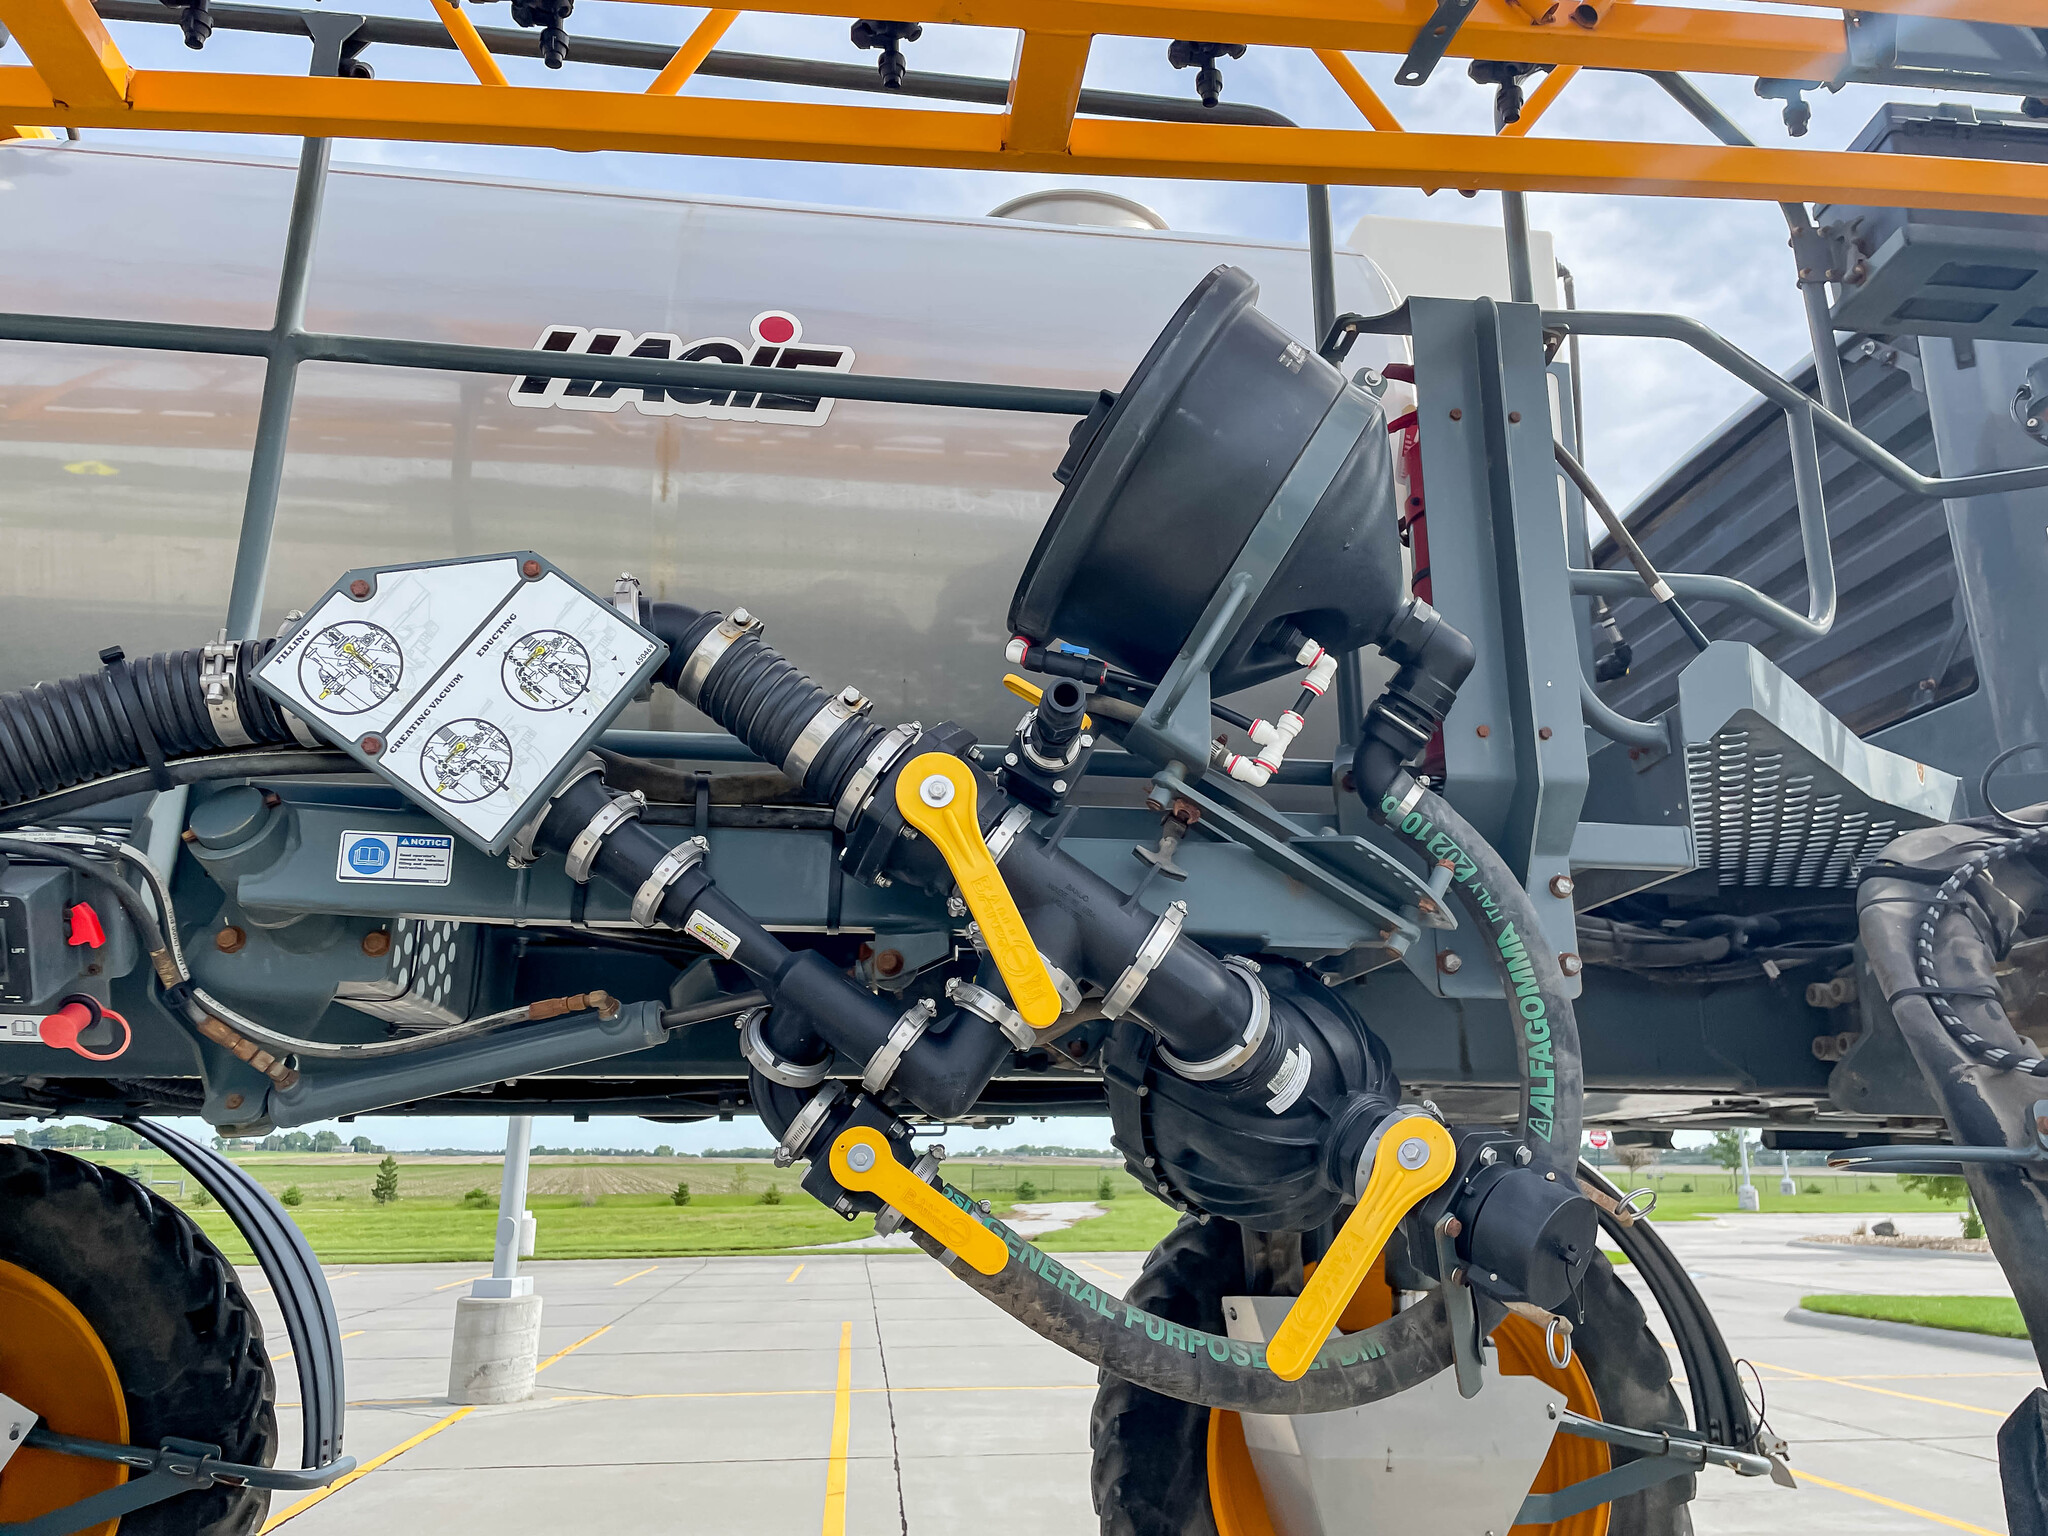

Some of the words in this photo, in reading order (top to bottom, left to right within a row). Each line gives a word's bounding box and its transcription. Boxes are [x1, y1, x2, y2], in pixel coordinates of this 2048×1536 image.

[274, 628, 310, 665] FILLING
[475, 612, 517, 658] EDUCTING
[635, 643, 654, 666] 650469
[389, 708, 431, 754] CREATING
[428, 672, 464, 709] VACUUM
[410, 837, 449, 847] NOTICE
[1467, 881, 1504, 923] ITALY
[1496, 920, 1555, 1121] ALFAGOMMA
[982, 1217, 1116, 1320] GENERAL
[1123, 1306, 1268, 1369] PURPOSE
